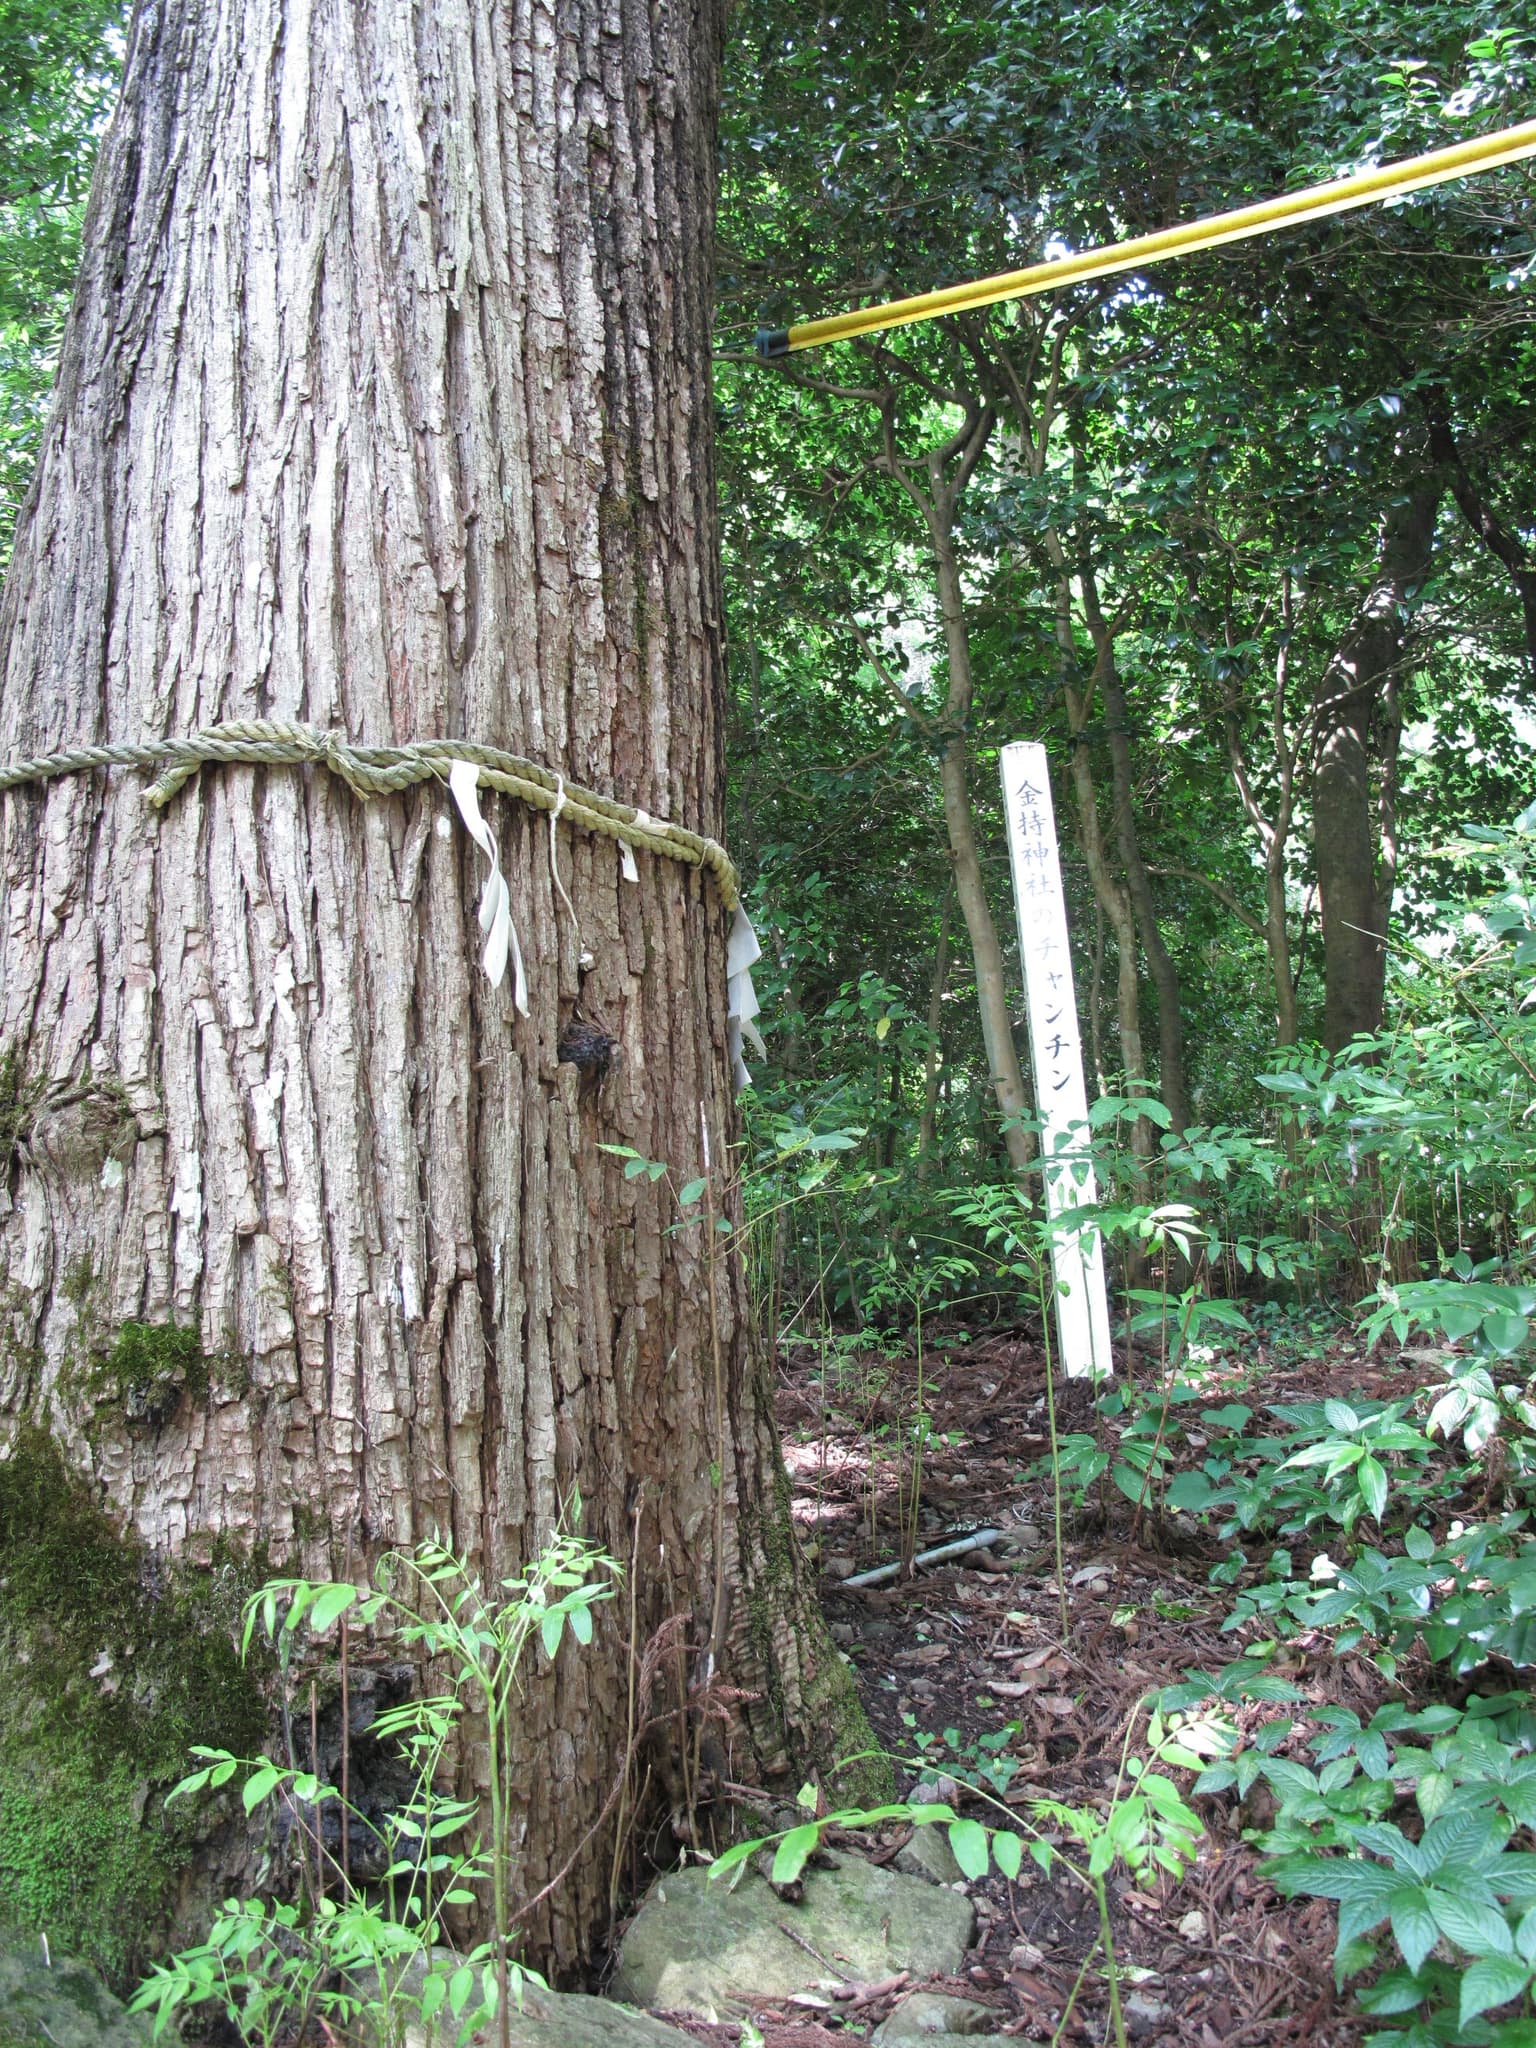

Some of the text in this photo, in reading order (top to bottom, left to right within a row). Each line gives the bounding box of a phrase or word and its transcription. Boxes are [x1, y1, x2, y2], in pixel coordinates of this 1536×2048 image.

[1015, 779, 1071, 1091] 金持神社のチャンチン
